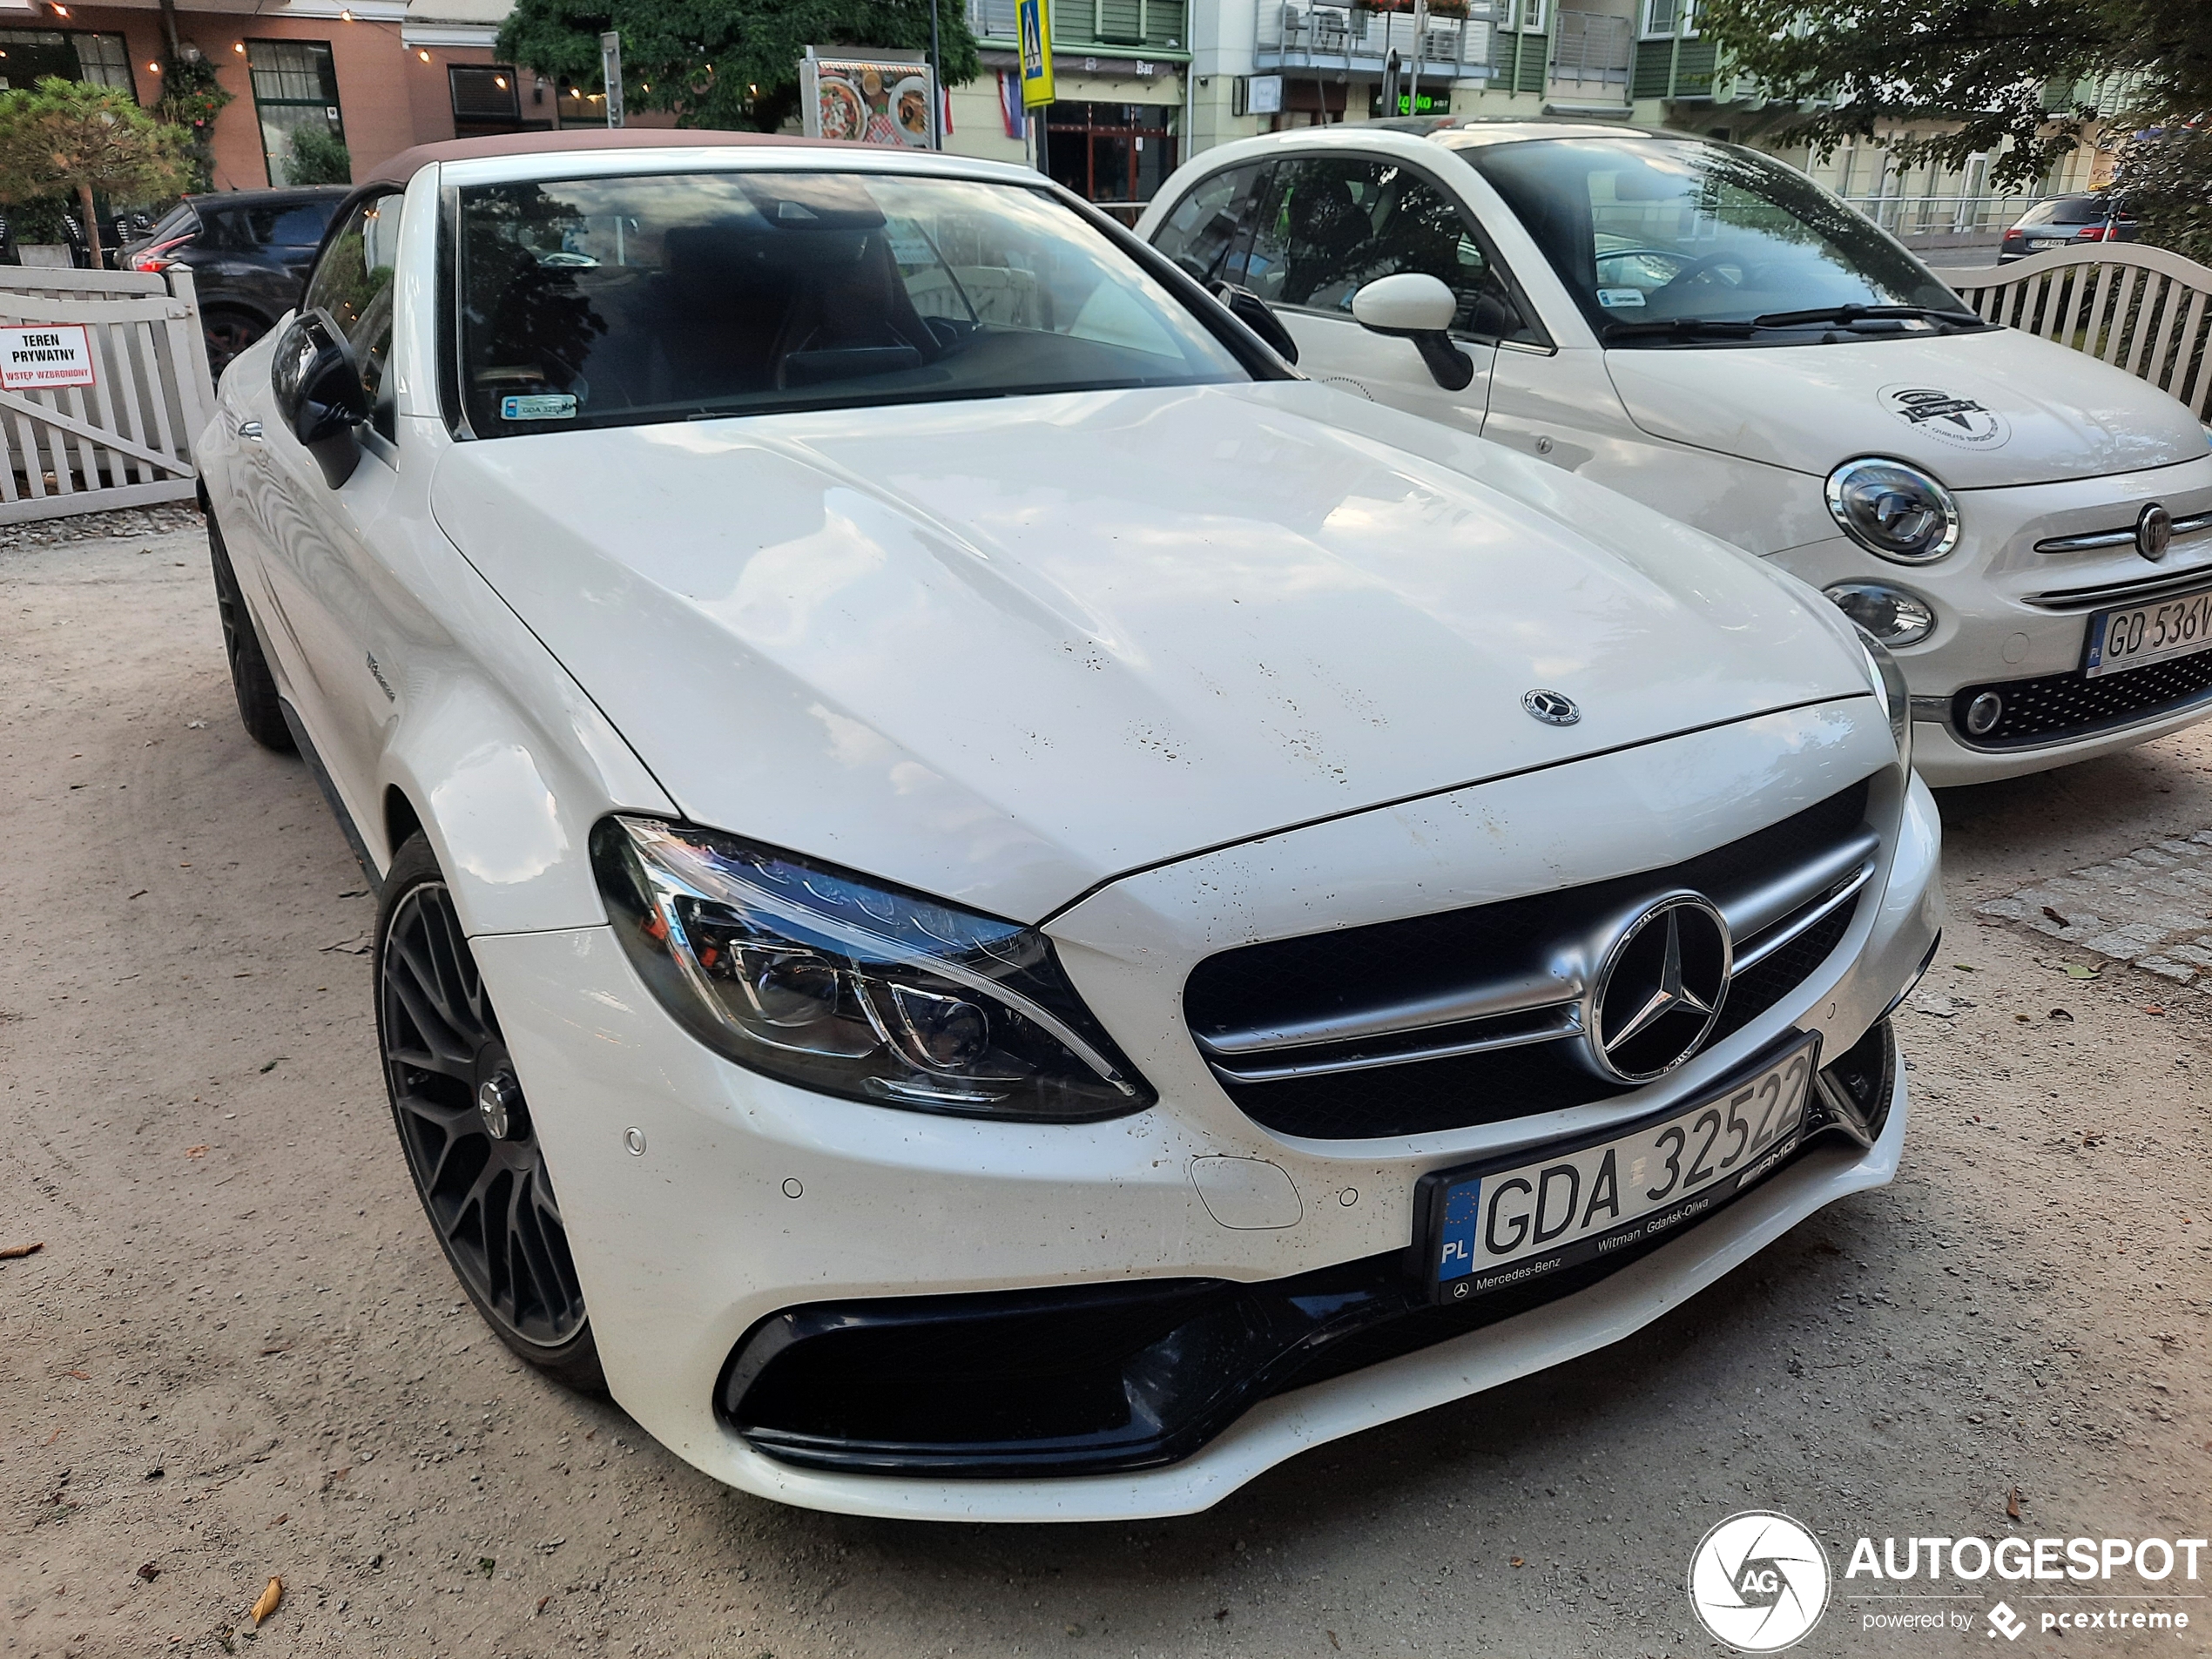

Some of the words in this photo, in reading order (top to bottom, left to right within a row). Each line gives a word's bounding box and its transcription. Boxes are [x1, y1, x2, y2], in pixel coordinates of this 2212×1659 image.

[22, 334, 60, 347] TEREN
[12, 349, 75, 363] PRYWATNY
[6, 371, 34, 381] WSTĘP
[37, 369, 88, 379] WZBRONIONY
[2108, 612, 2146, 658] GD
[2090, 647, 2100, 658] PL
[1485, 1148, 1620, 1255] GDA
[1646, 1055, 1807, 1201] 32522
[1441, 1239, 1468, 1264] PL
[1476, 1258, 1561, 1291] Mercedes-Benz
[1598, 1229, 1641, 1252] Witman
[1647, 1197, 1710, 1233] Gdańsk-Oliwa
